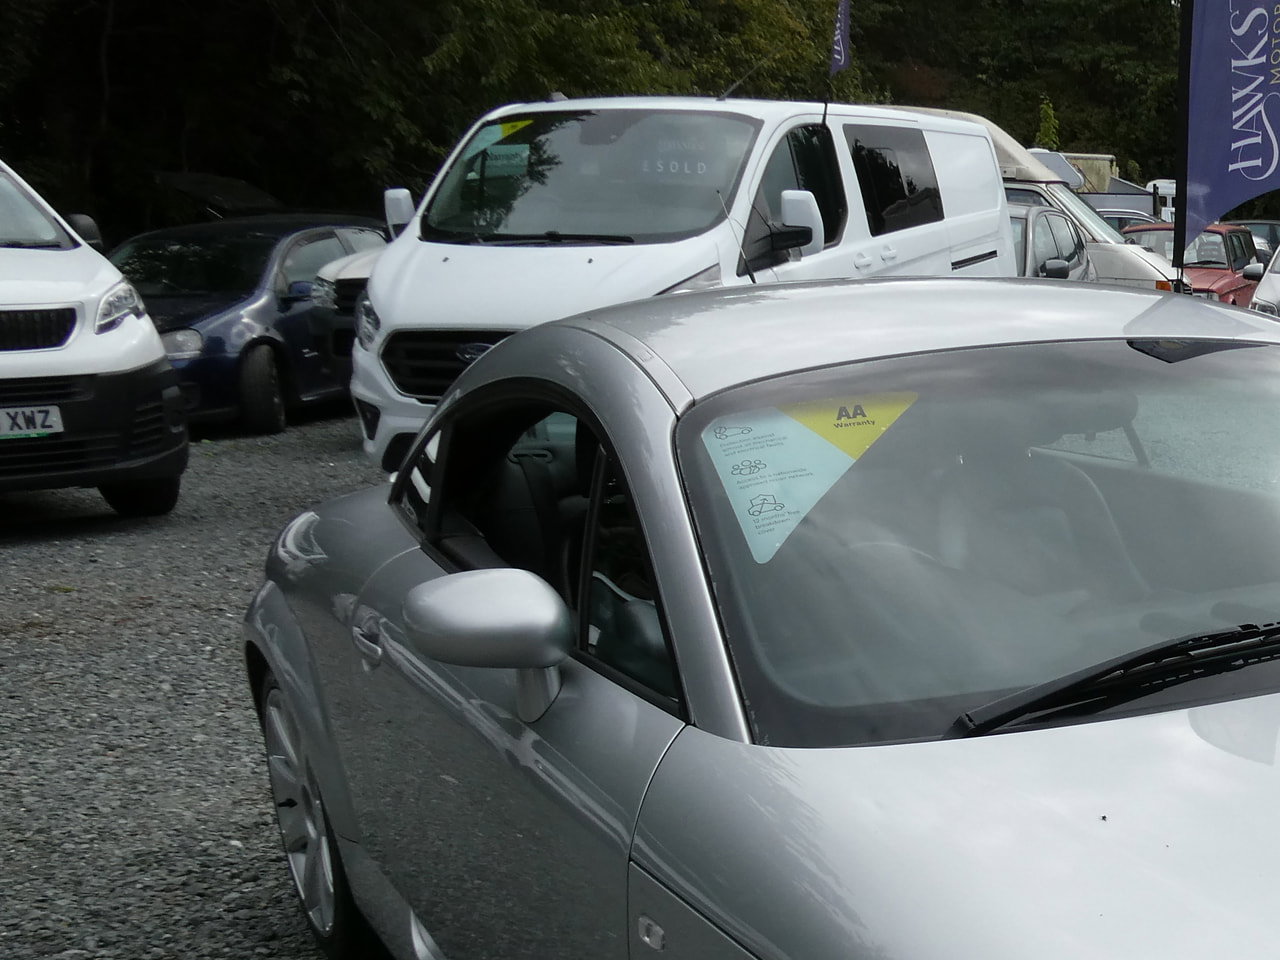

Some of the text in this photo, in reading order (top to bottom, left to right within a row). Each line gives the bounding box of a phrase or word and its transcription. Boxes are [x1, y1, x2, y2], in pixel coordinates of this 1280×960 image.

[1228, 0, 1280, 181] HAWKS
[657, 160, 706, 174] SOLD
[6, 409, 54, 431] XWZ
[836, 404, 867, 421] AA
[833, 419, 876, 429] Warranty
